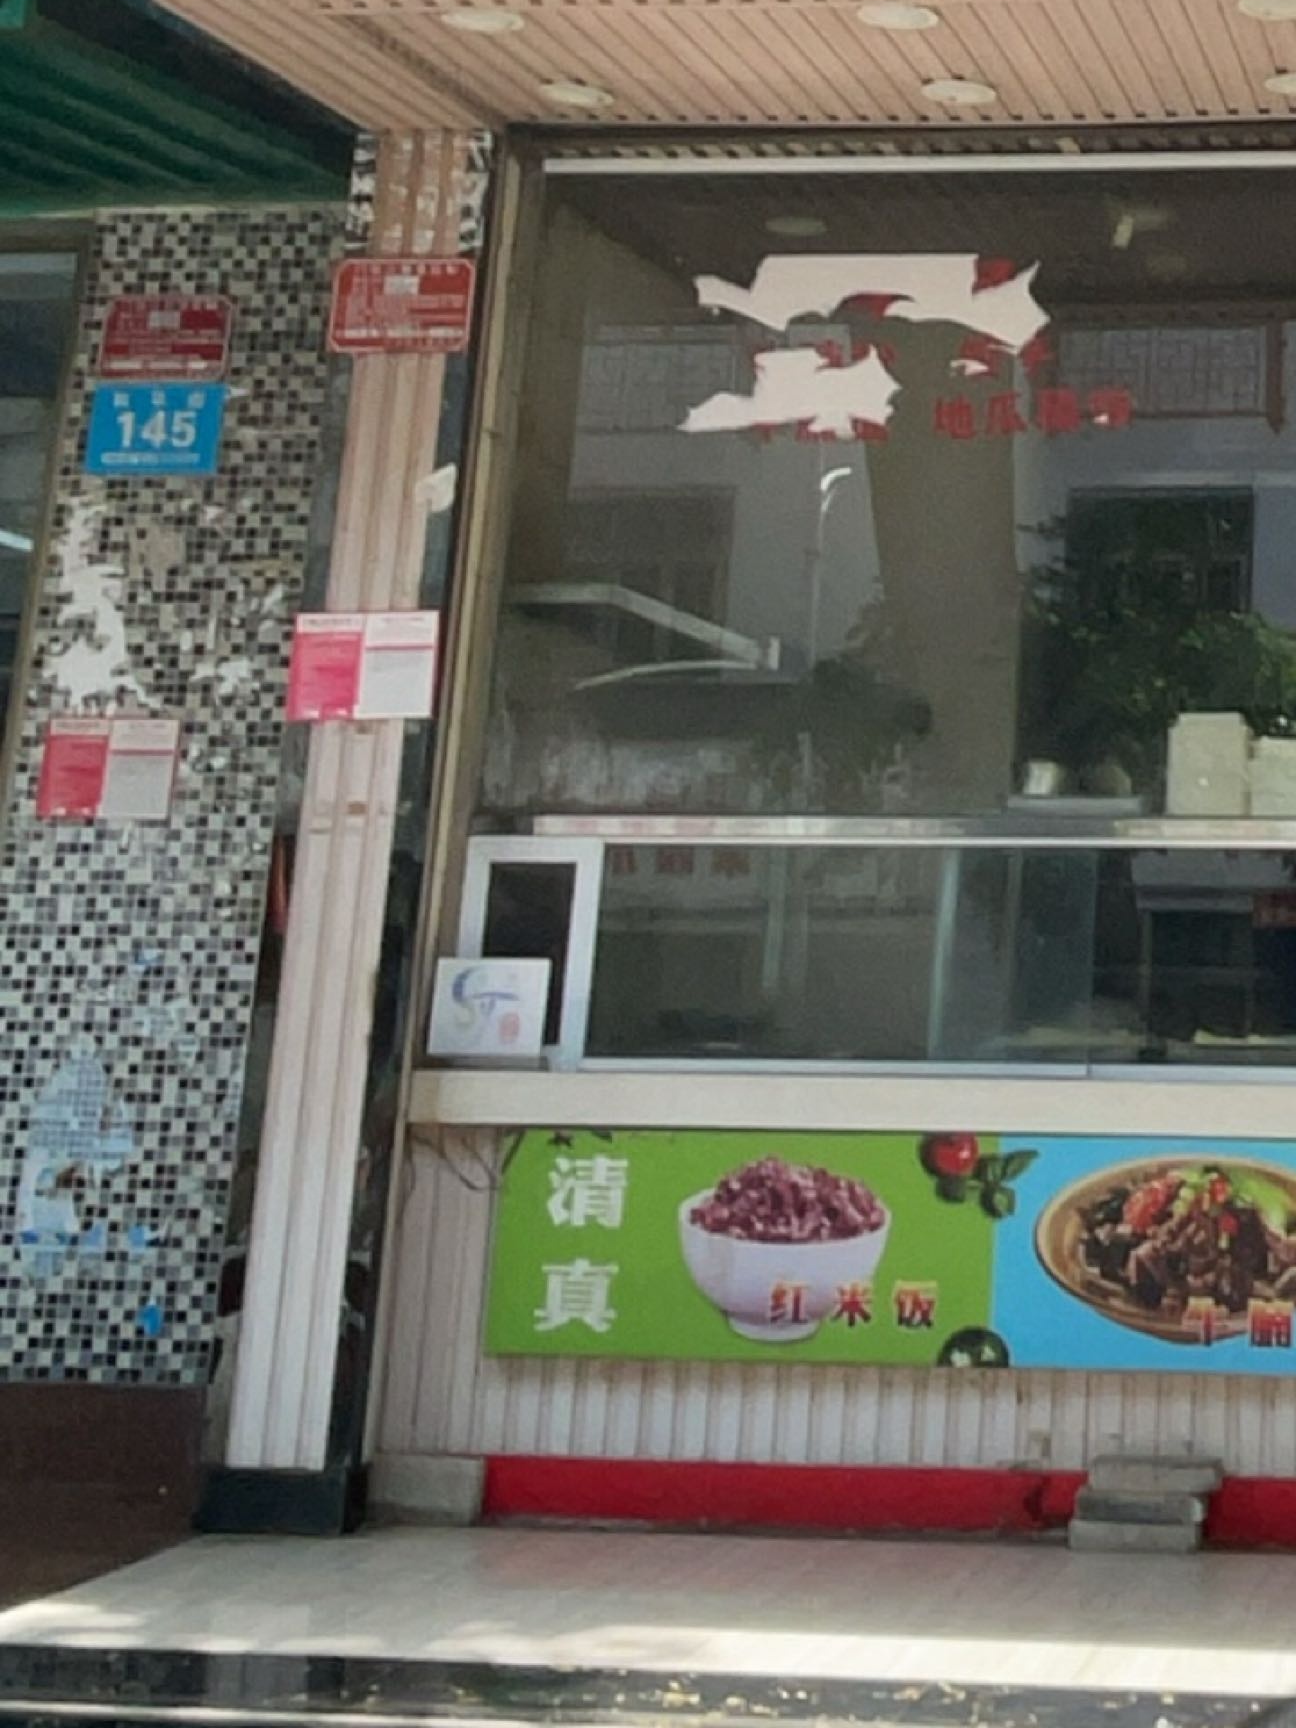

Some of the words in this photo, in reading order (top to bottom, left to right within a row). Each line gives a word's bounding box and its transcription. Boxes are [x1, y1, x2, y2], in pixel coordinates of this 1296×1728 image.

[116, 410, 198, 448] 145
[533, 1156, 629, 1333] 清真
[770, 1279, 938, 1328] 红米饭
